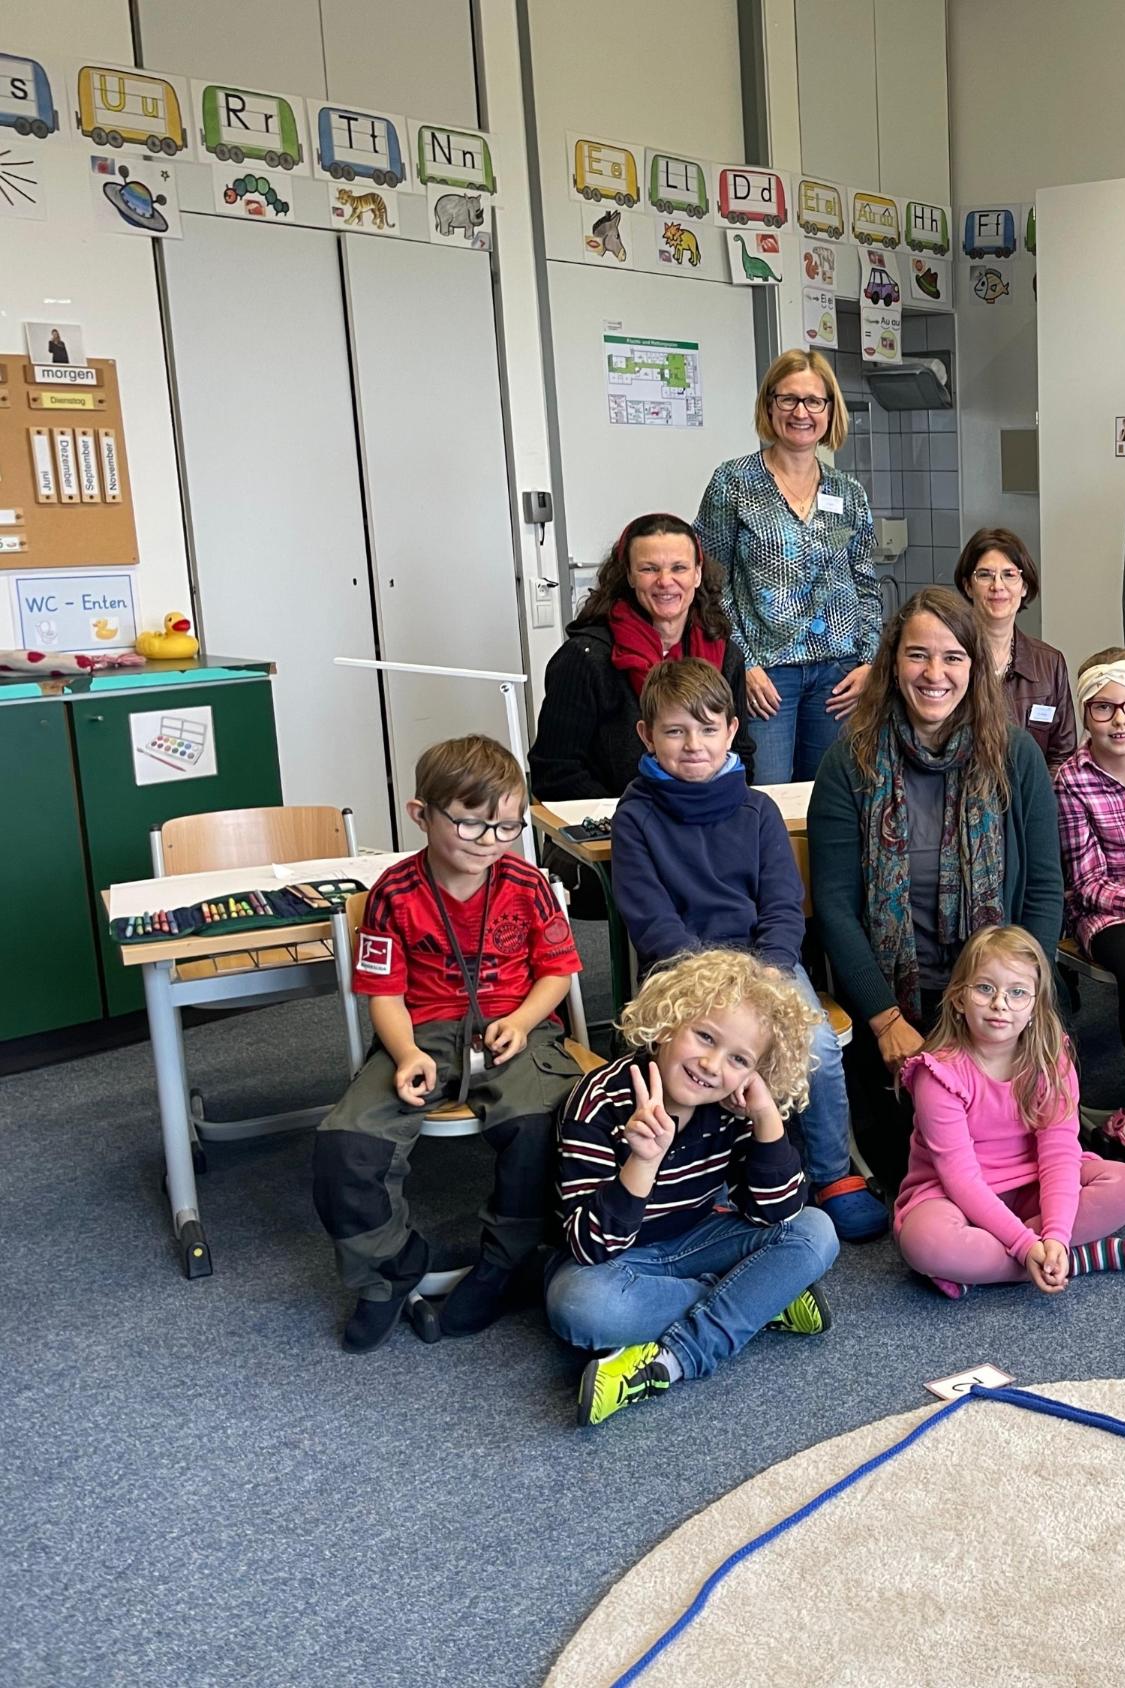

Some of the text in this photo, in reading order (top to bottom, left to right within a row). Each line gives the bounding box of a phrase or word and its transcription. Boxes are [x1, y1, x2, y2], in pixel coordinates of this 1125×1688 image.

[11, 77, 28, 100] s
[42, 366, 95, 382] morgen
[50, 396, 86, 407] Dienstag
[59, 439, 71, 488] Dezember
[81, 440, 94, 491] September
[107, 442, 117, 492] November
[43, 470, 52, 491] Juni
[25, 595, 58, 613] WC
[82, 593, 127, 611] Enten
